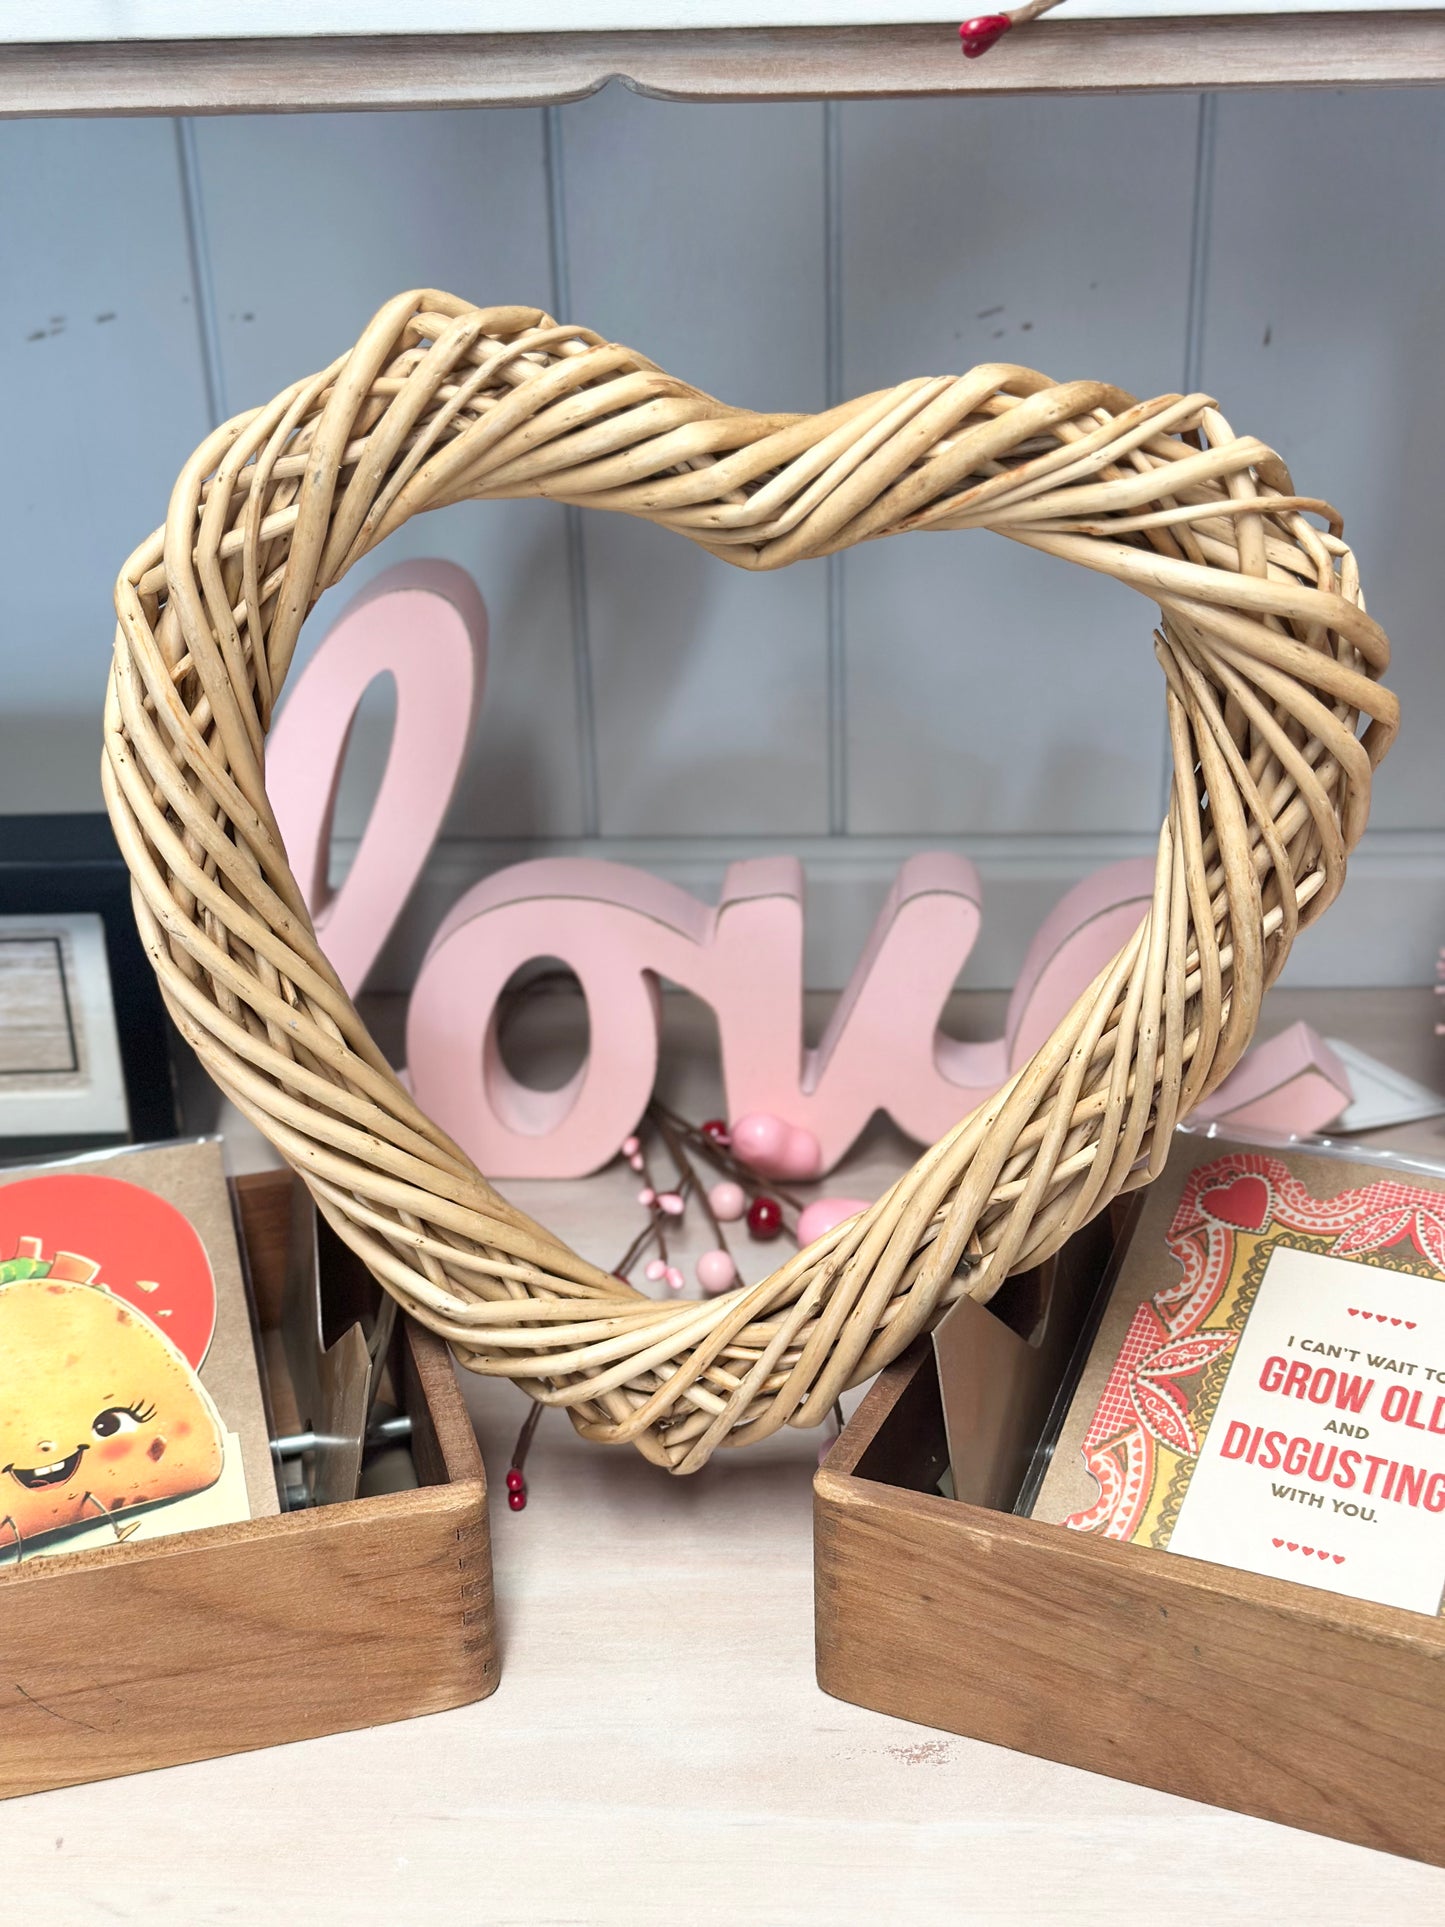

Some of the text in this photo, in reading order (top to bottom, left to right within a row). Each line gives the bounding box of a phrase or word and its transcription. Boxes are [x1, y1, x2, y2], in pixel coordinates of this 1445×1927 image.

[1288, 1336, 1295, 1347] I
[1300, 1339, 1361, 1362] CAN'T
[1366, 1353, 1418, 1376] WAIT
[1259, 1356, 1445, 1435] GROW OLD
[1323, 1419, 1370, 1440] AND
[1219, 1420, 1445, 1513] DISGUSTING
[1271, 1482, 1378, 1523] WITH YOU.
